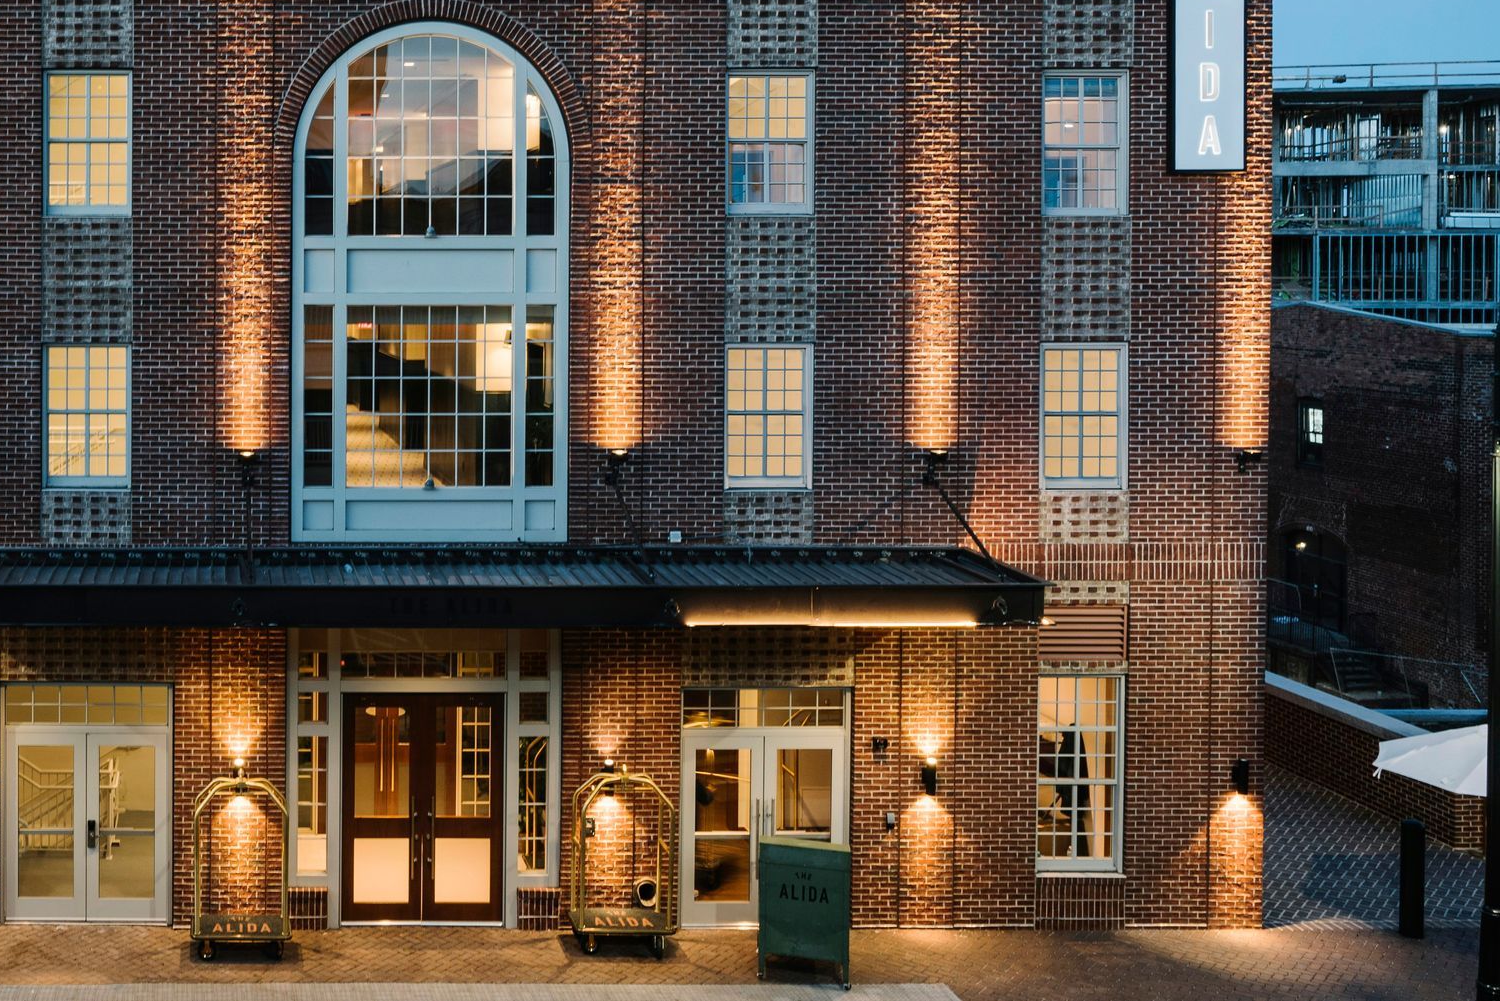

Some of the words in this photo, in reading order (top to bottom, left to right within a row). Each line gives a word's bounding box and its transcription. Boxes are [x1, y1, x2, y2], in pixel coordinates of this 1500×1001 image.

[780, 883, 829, 904] ALIDA
[595, 916, 654, 927] ALIDA
[212, 922, 271, 933] ALIDA
